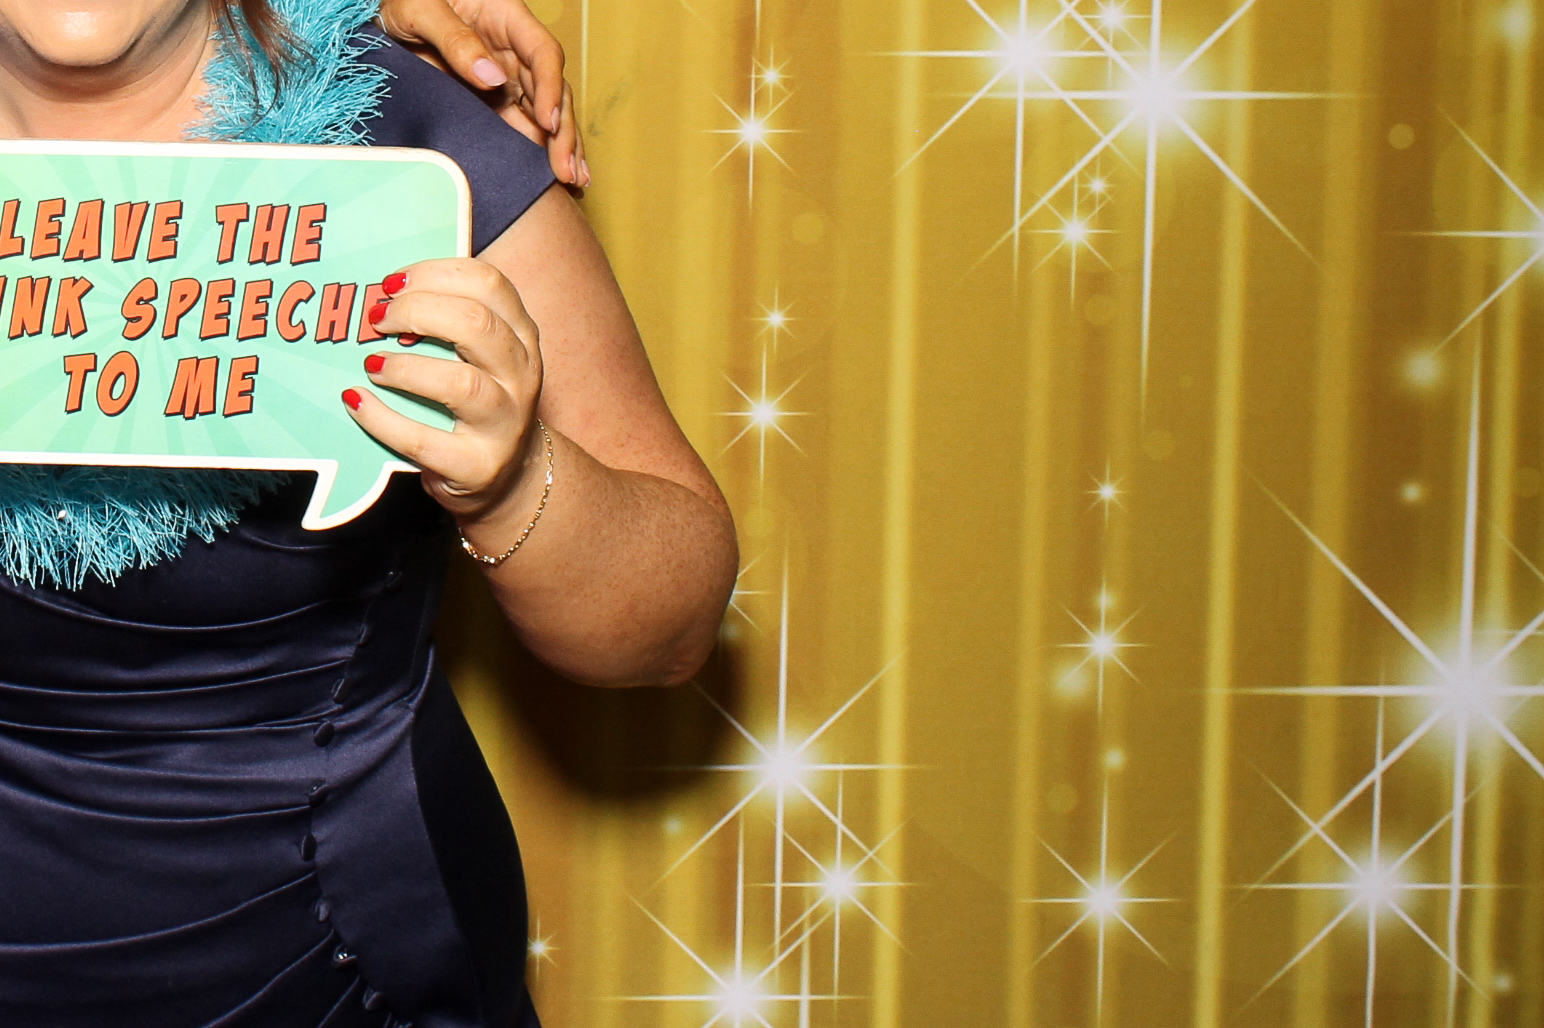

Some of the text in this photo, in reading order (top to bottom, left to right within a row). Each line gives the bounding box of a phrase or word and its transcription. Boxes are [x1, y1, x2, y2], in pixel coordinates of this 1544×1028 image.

[215, 203, 327, 264] THE
[121, 279, 424, 347] SPEECHE
[63, 351, 259, 418] TO ME
